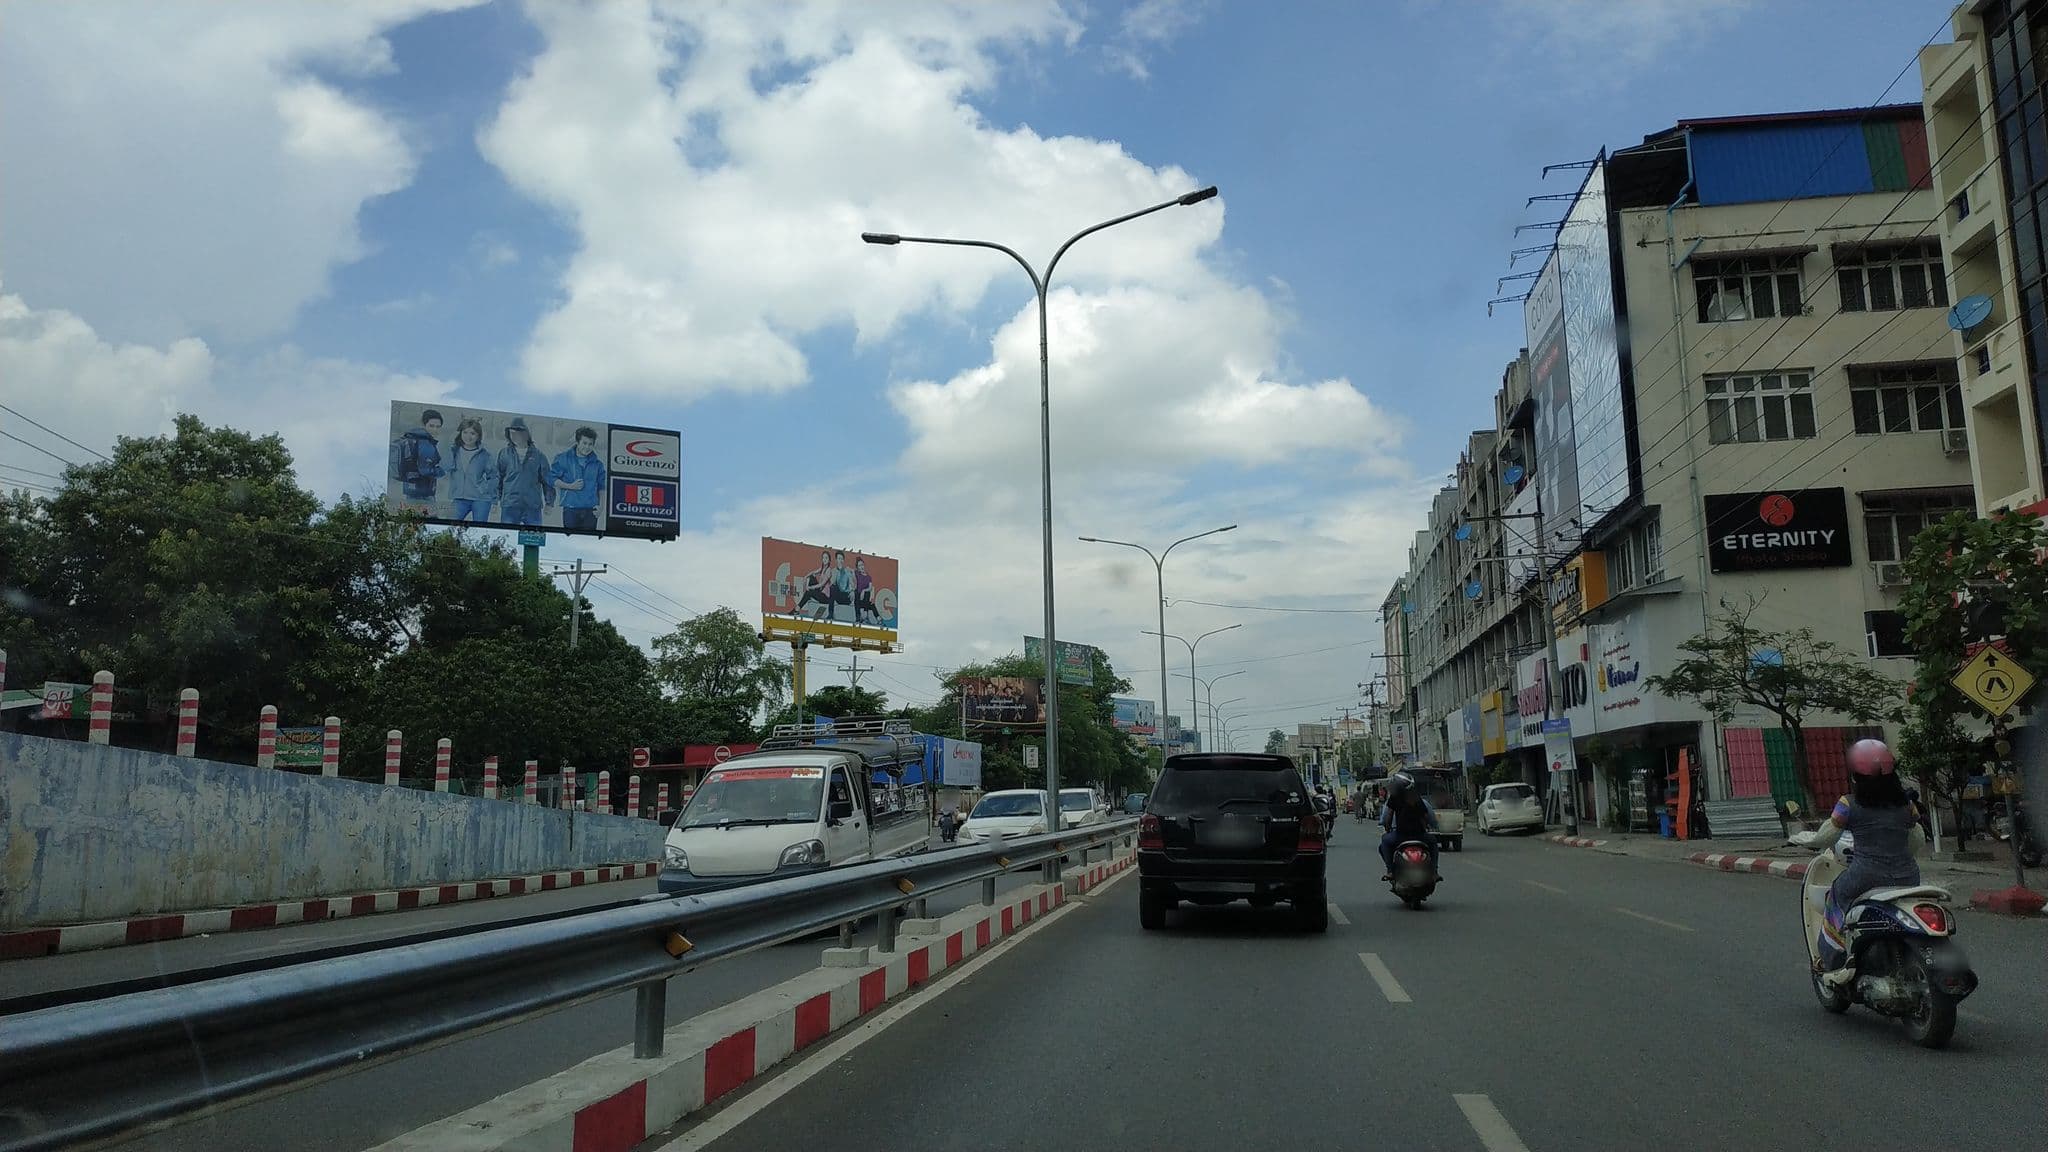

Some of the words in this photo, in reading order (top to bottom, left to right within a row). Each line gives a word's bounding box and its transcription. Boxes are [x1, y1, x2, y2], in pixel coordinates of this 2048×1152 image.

[614, 455, 676, 470] Giorenzo
[615, 502, 673, 516] Giorenzo
[625, 520, 663, 529] COLLECTION
[1723, 529, 1836, 549] ETERNITY
